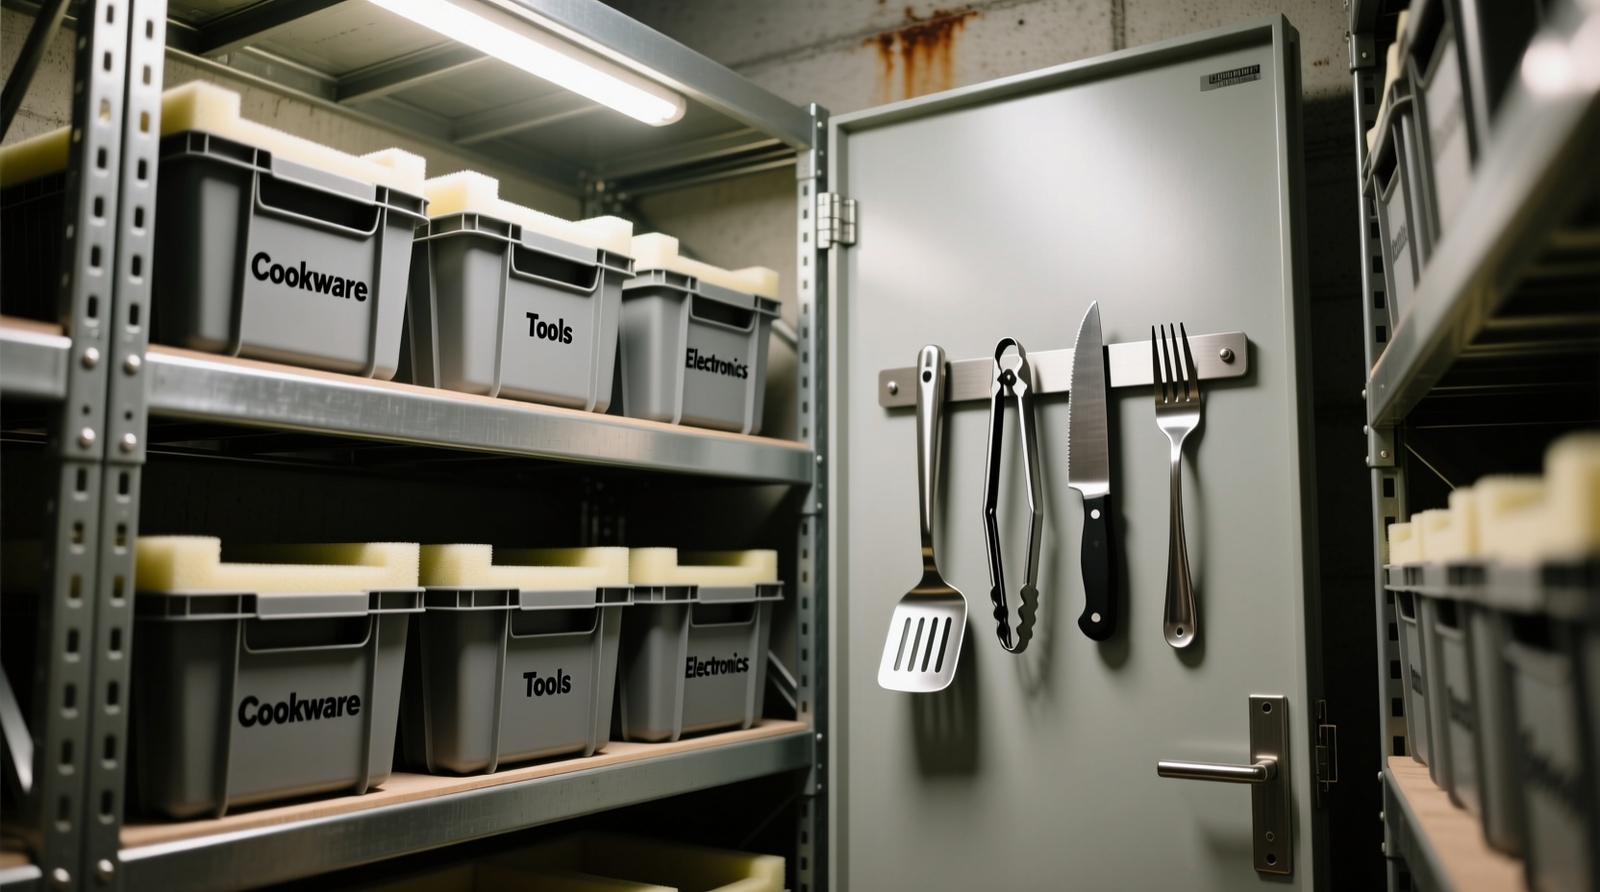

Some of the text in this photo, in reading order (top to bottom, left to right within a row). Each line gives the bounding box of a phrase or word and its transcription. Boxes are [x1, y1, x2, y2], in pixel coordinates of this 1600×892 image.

[251, 251, 369, 303] Cookware
[526, 311, 573, 345] Tools
[685, 347, 749, 380] Electronics
[684, 652, 750, 680] Electronics
[522, 668, 571, 698] Tools
[237, 691, 362, 728] Cookware
